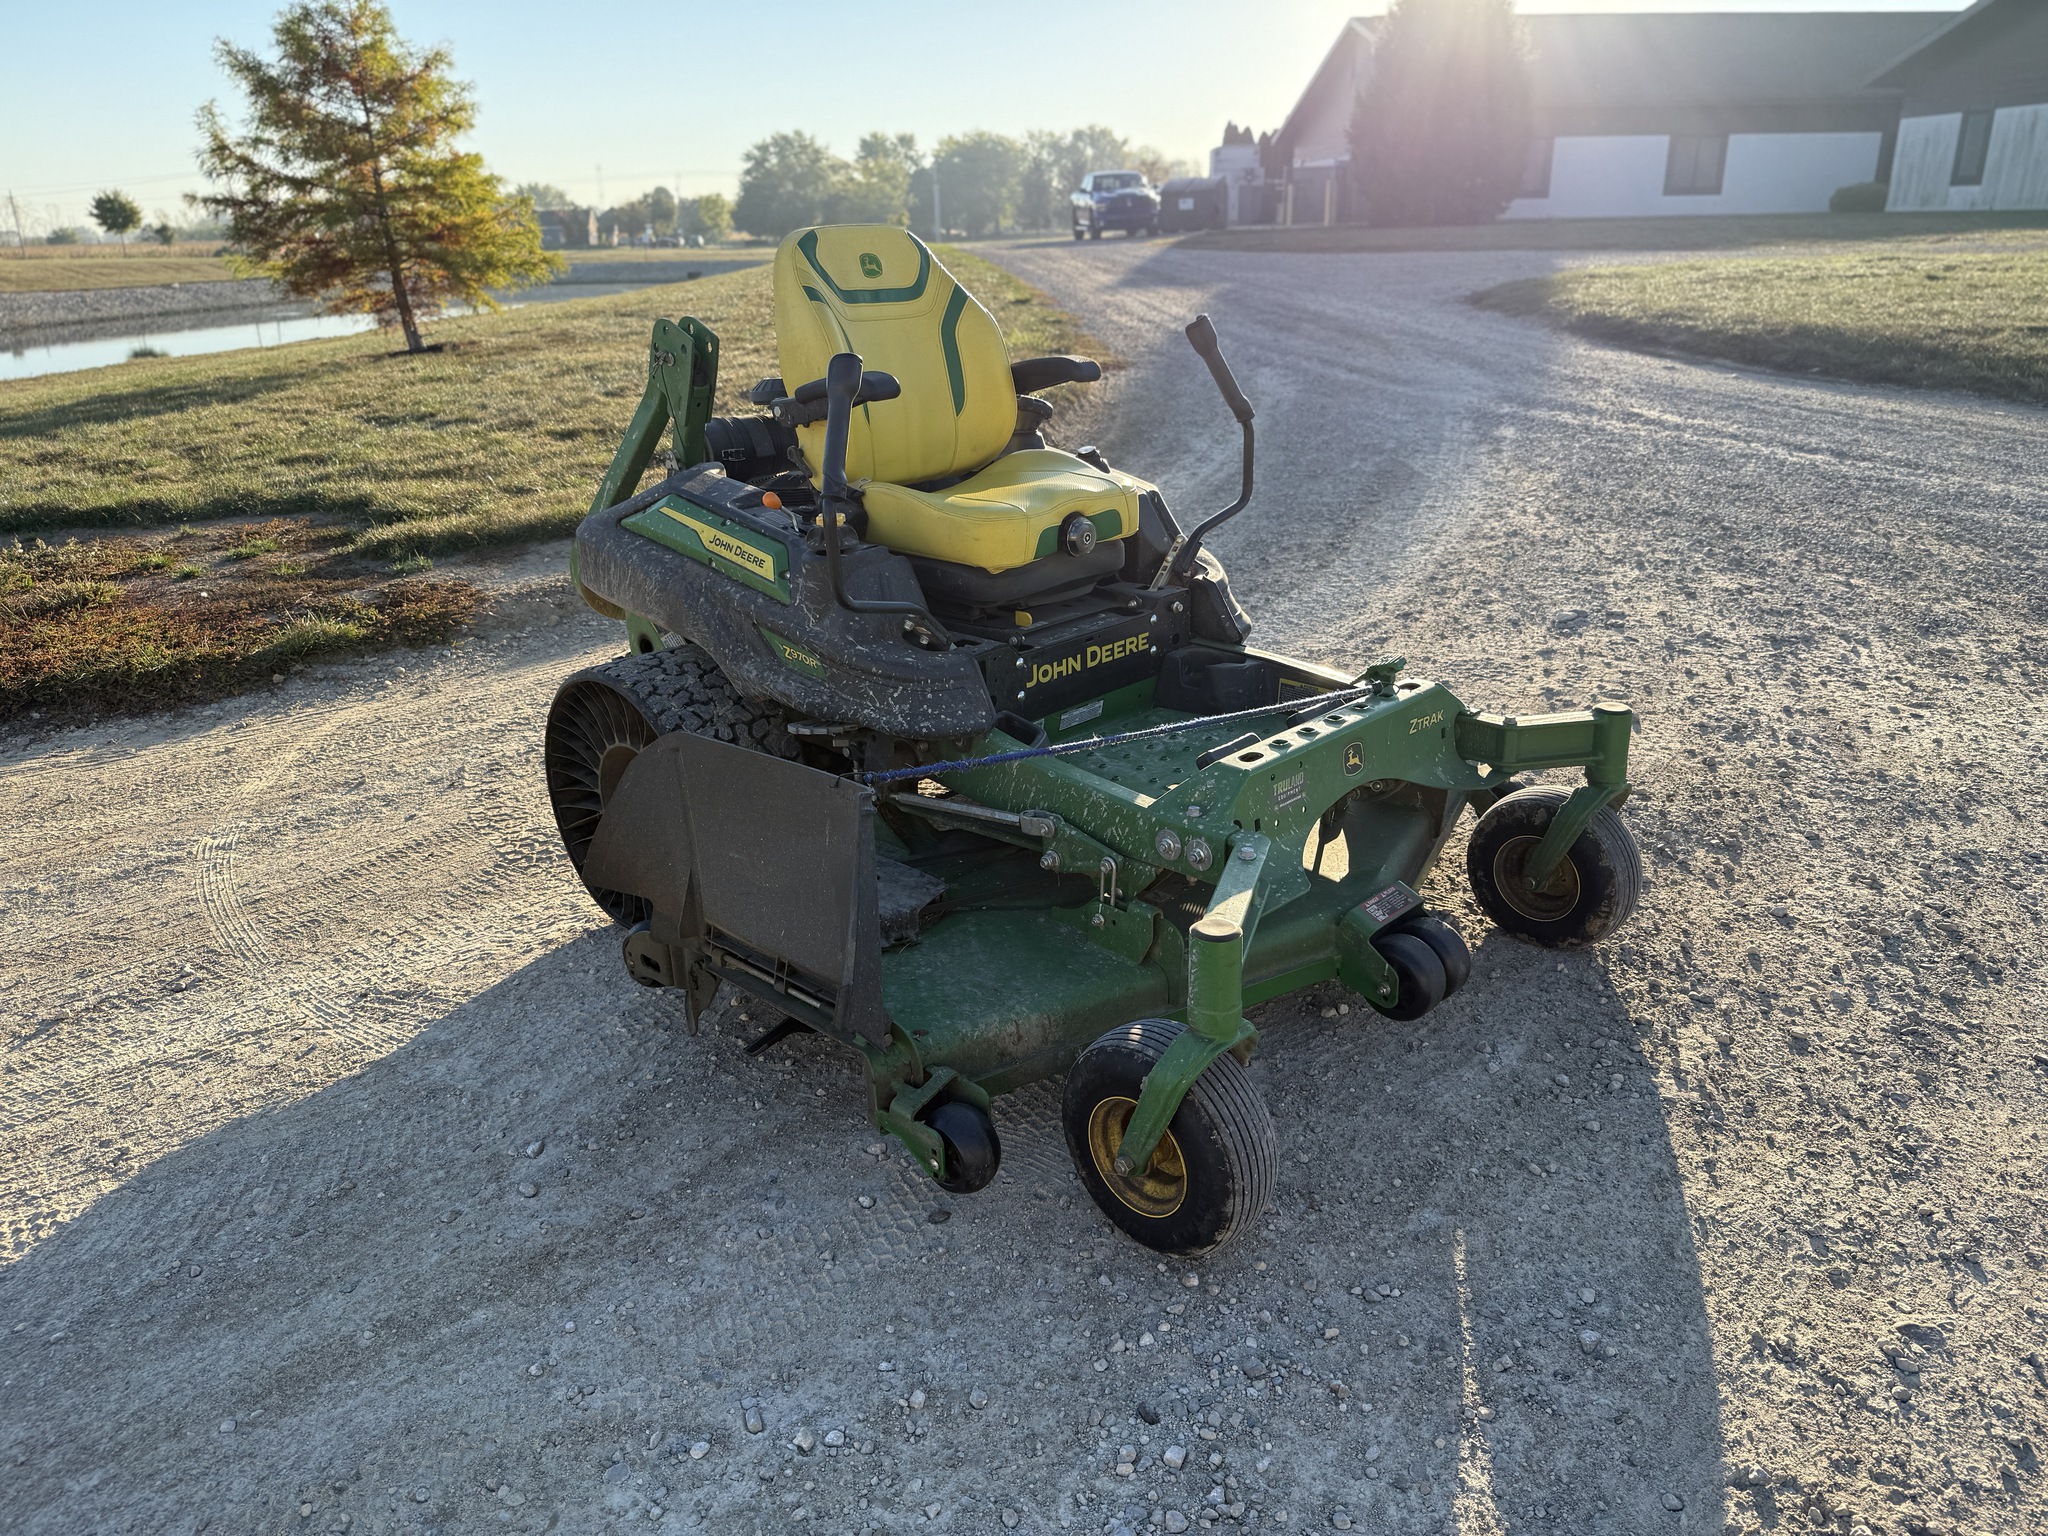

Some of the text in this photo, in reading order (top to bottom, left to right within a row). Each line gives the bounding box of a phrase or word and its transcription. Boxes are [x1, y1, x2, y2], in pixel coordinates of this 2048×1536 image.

[709, 534, 766, 569] JOHN DEERE
[1026, 632, 1150, 688] JOHN DEERE
[1409, 709, 1445, 735] ZTRAK
